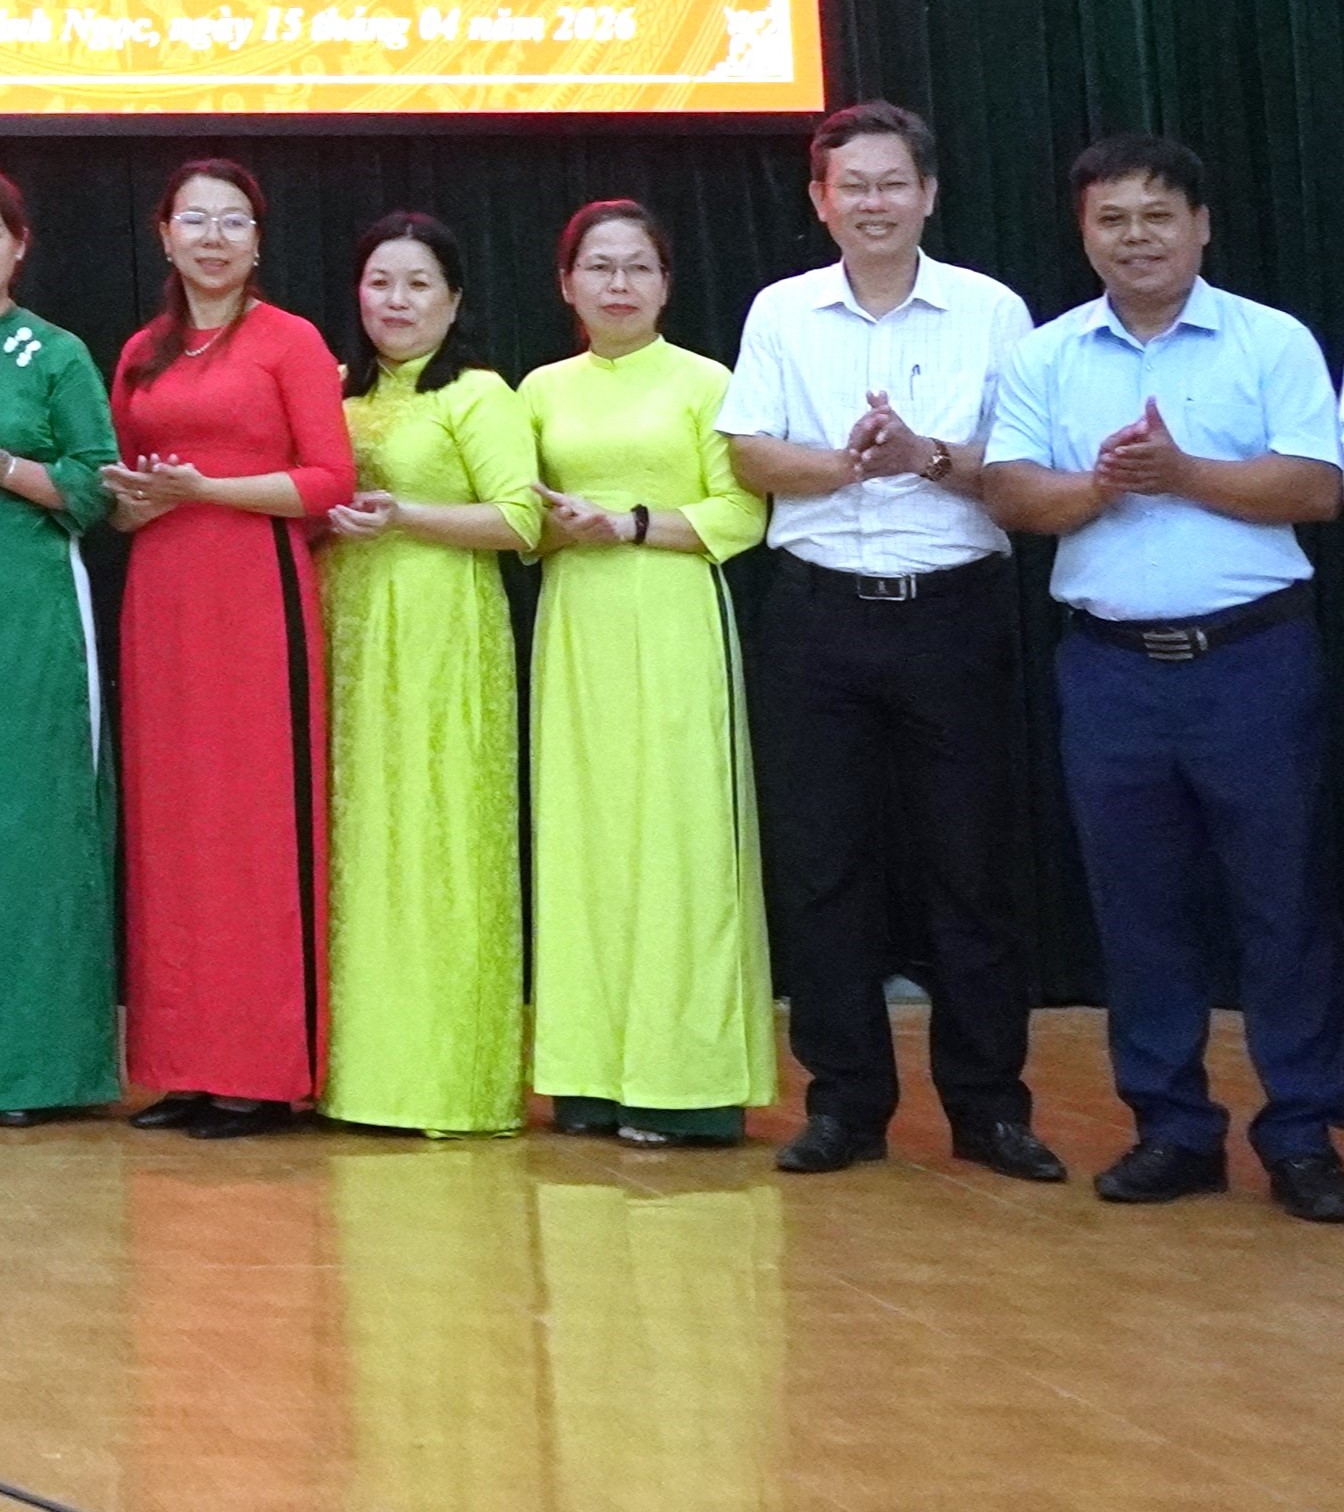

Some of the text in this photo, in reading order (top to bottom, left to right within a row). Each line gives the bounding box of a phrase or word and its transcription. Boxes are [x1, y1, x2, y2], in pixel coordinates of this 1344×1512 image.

[169, 6, 253, 51] ngày
[263, 7, 302, 42] 15
[311, 6, 410, 50] tháng
[419, 6, 460, 41] 04
[469, 7, 544, 42] năm
[554, 5, 635, 42] 2026
